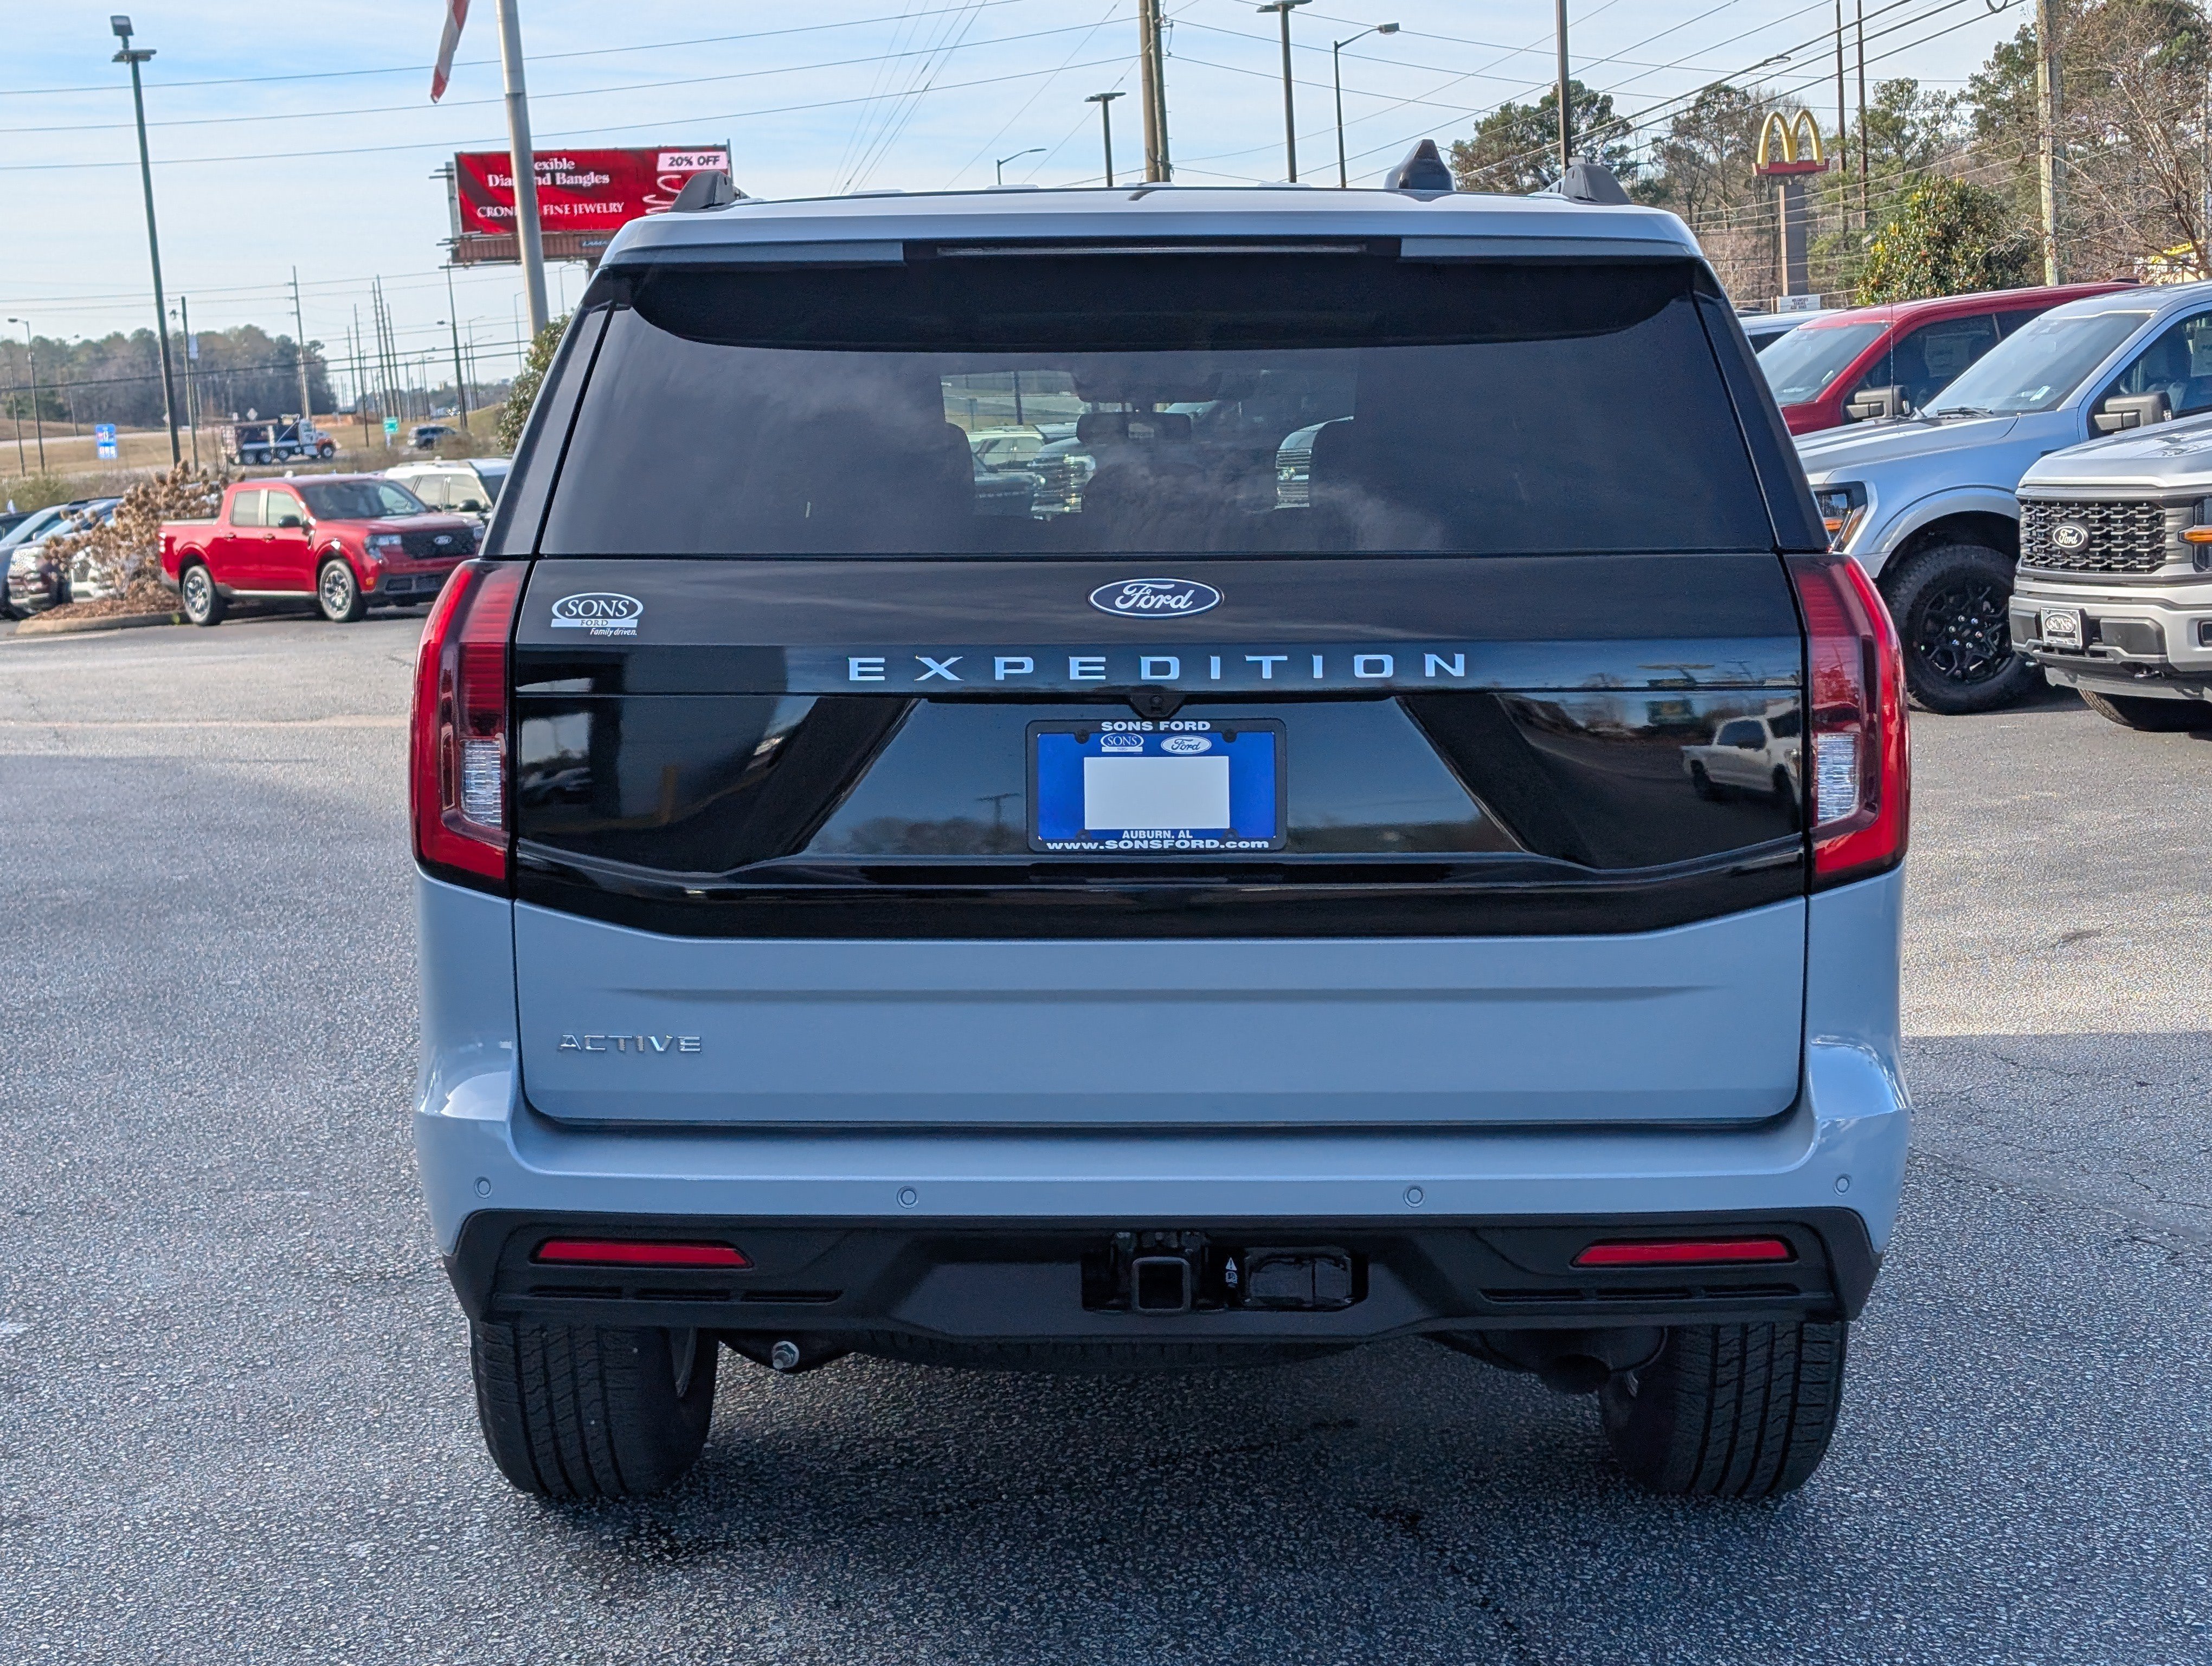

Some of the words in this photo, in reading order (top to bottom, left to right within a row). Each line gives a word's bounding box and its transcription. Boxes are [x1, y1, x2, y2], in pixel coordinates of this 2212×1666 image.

[533, 158, 575, 170] exible
[668, 156, 693, 166] 20%
[697, 155, 720, 165] OFF
[487, 172, 551, 187] Diand
[555, 171, 610, 187] Bangles
[543, 203, 570, 215] FINE
[573, 202, 624, 216] JEWELRY
[2059, 529, 2079, 544] Ford
[1115, 583, 1195, 608] Ford
[565, 600, 629, 617] SONS
[590, 627, 614, 637] Family
[614, 627, 638, 636] driven.
[848, 653, 1465, 681] EXPEDITION
[1101, 721, 1153, 731] SONS
[1160, 721, 1211, 731] FORD
[1107, 735, 1137, 746] SONS
[1171, 738, 1201, 751] Ford
[1178, 830, 1193, 838] AL
[1046, 840, 1269, 850] www.SONSFORD.com
[558, 1034, 702, 1052] ACTIVE
